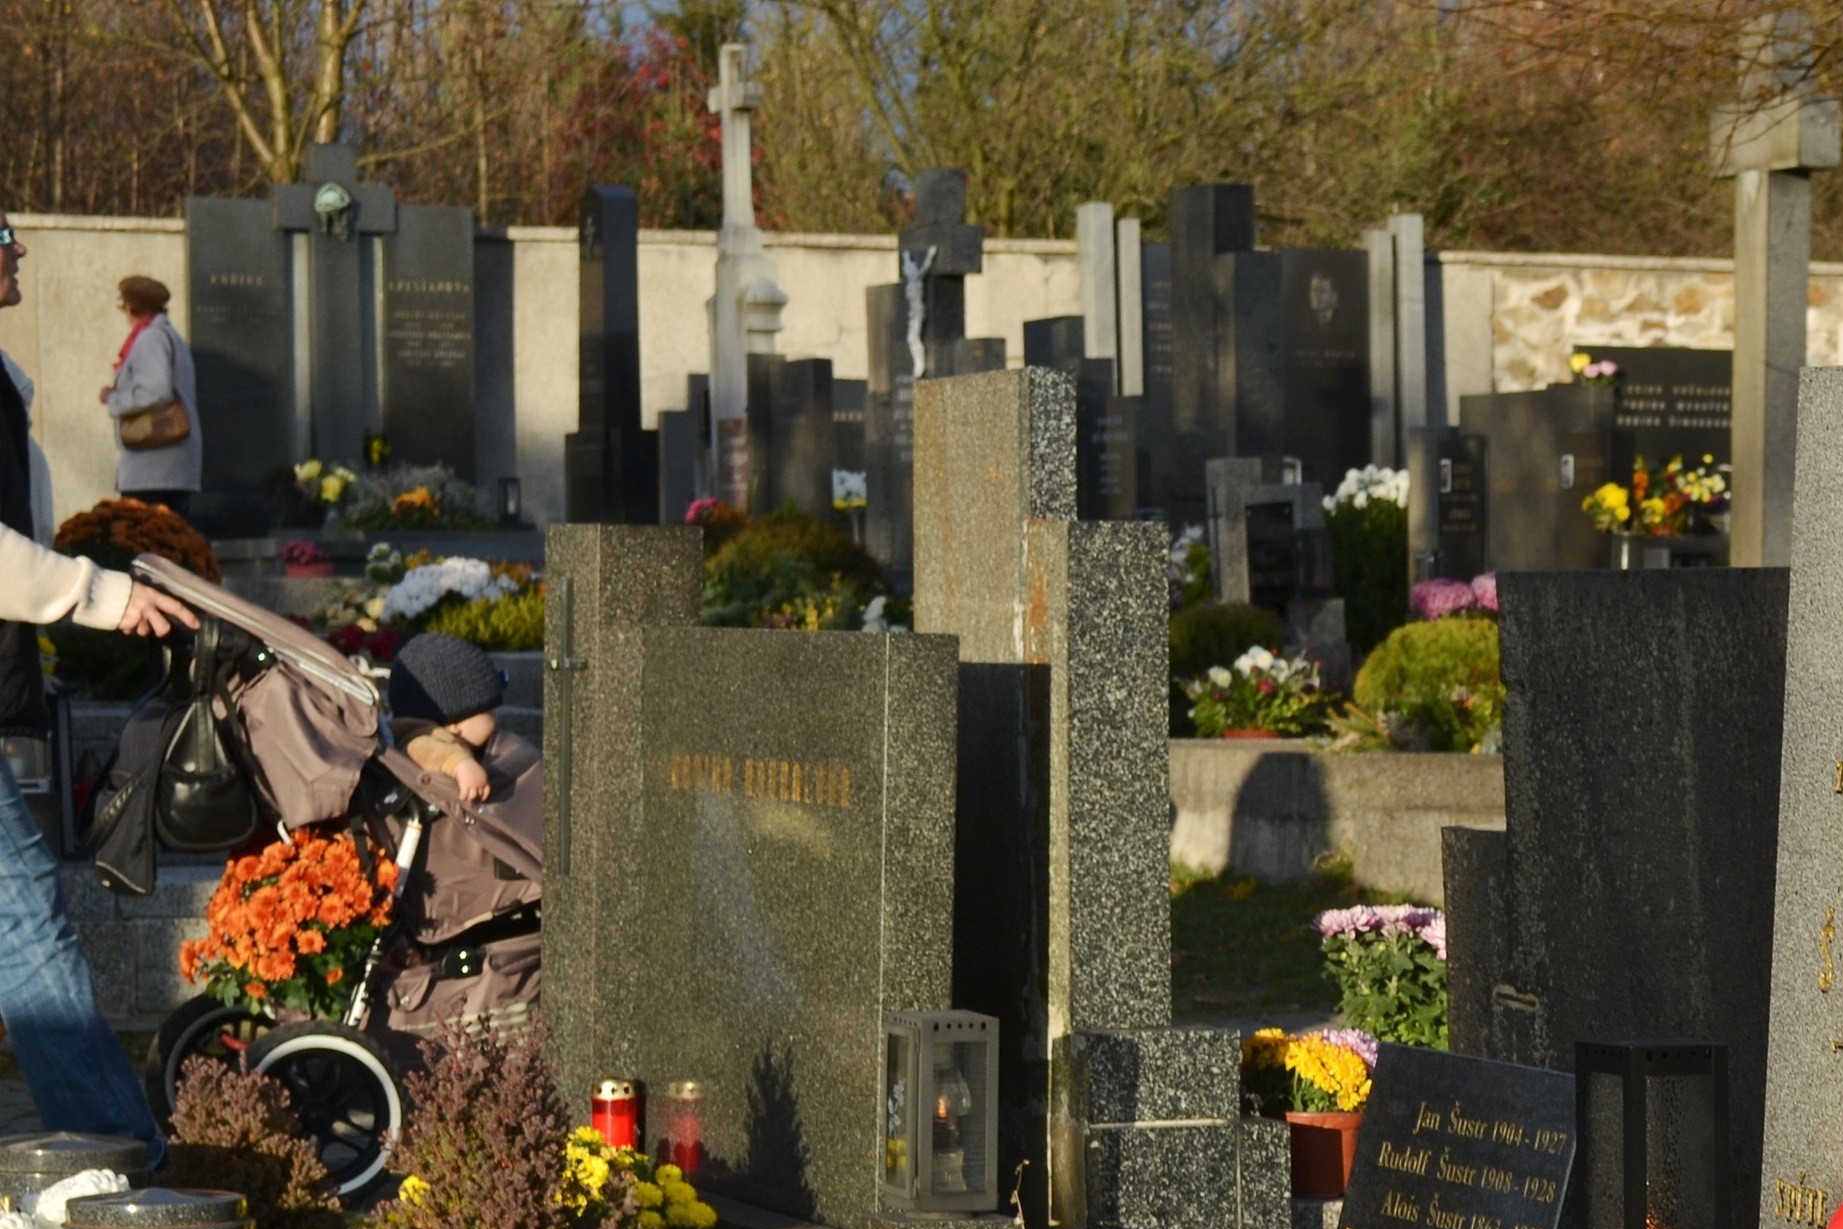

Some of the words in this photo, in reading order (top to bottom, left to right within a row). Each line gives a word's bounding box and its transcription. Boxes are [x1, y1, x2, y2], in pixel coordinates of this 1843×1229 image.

[1413, 1101, 1441, 1135] Jan
[1448, 1100, 1488, 1139] Šustr
[1492, 1121, 1523, 1146] 1904
[1534, 1129, 1567, 1155] 1927
[1378, 1141, 1432, 1176] Rudolf
[1437, 1146, 1475, 1186] Šustr
[1481, 1167, 1512, 1193] 1908
[1523, 1177, 1556, 1204] 1928
[1381, 1190, 1420, 1223] Alois
